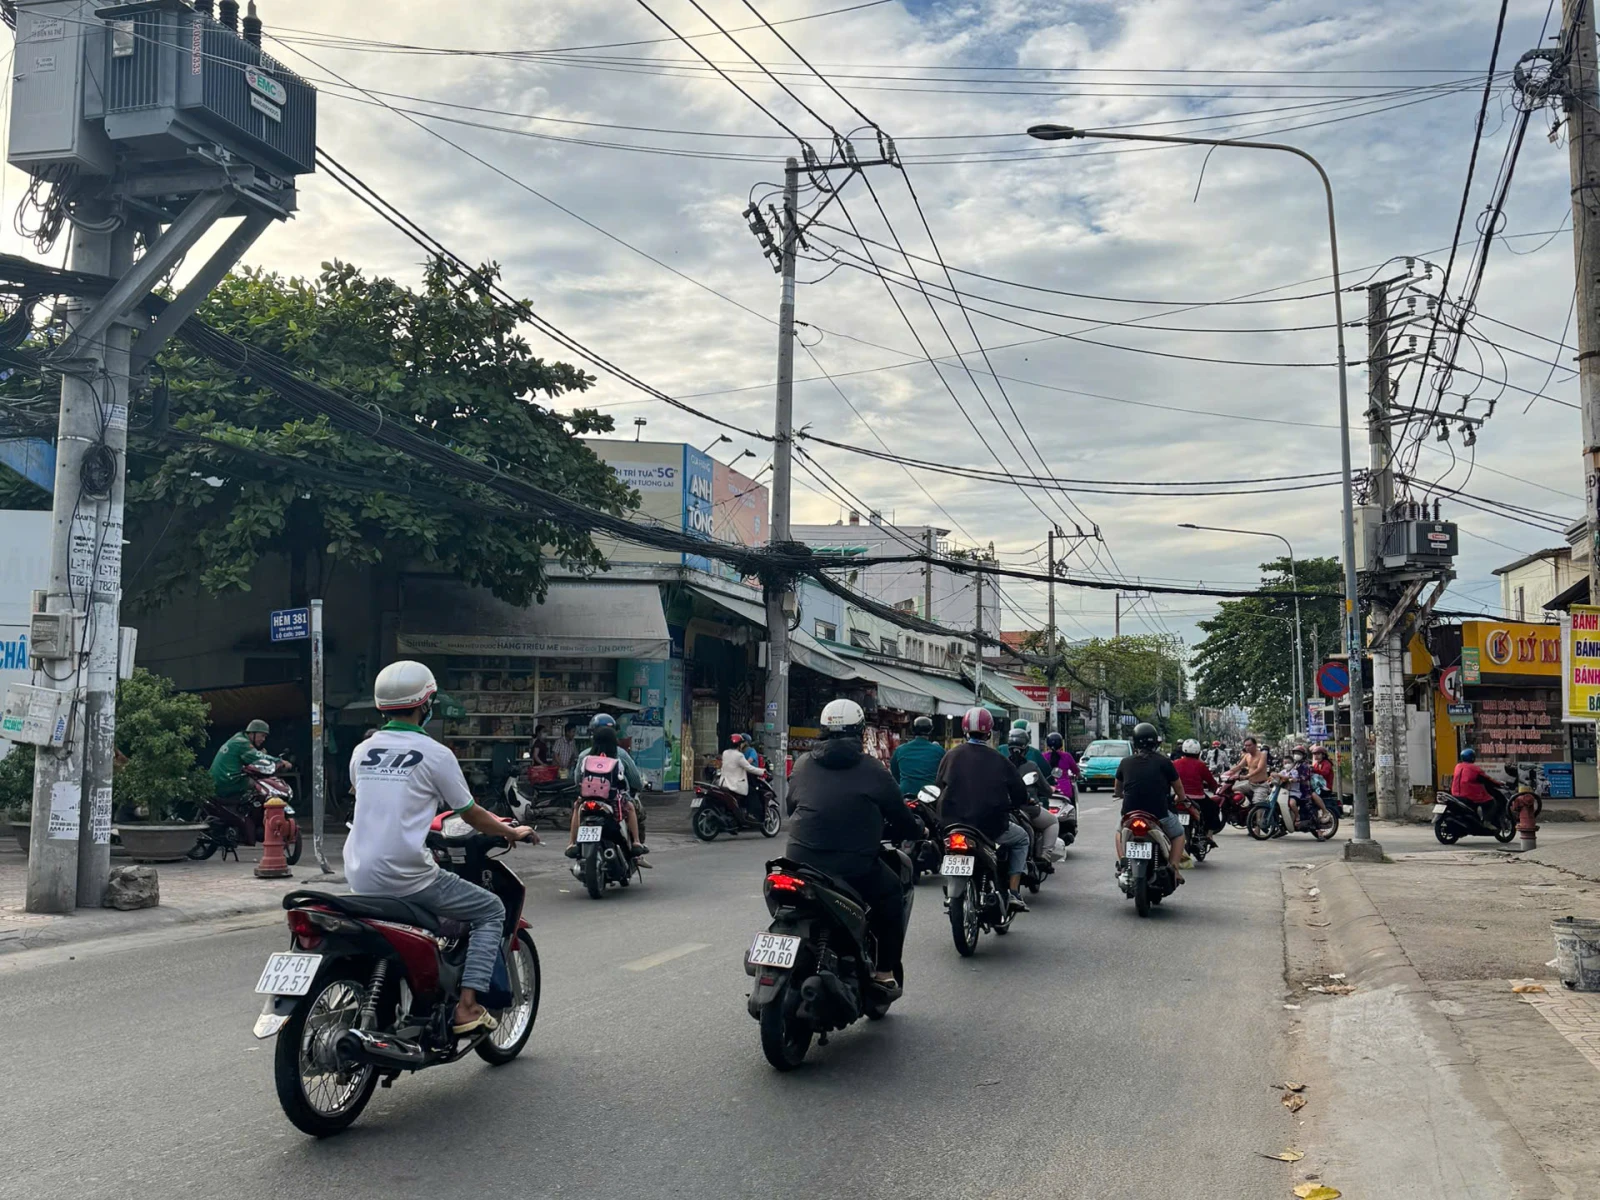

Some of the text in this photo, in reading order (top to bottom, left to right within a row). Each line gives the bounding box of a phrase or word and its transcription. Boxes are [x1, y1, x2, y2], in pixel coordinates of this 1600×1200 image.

[257, 75, 276, 96] EMC
[690, 474, 712, 502] ANH
[273, 611, 307, 627] HẺM 381
[1572, 611, 1598, 630] BÁNH
[1518, 631, 1537, 662] LÝ
[1575, 638, 1600, 657] BÁNH
[1574, 665, 1600, 684] BÁNH
[752, 949, 793, 966] 270.60
[262, 974, 310, 992] 112.57
